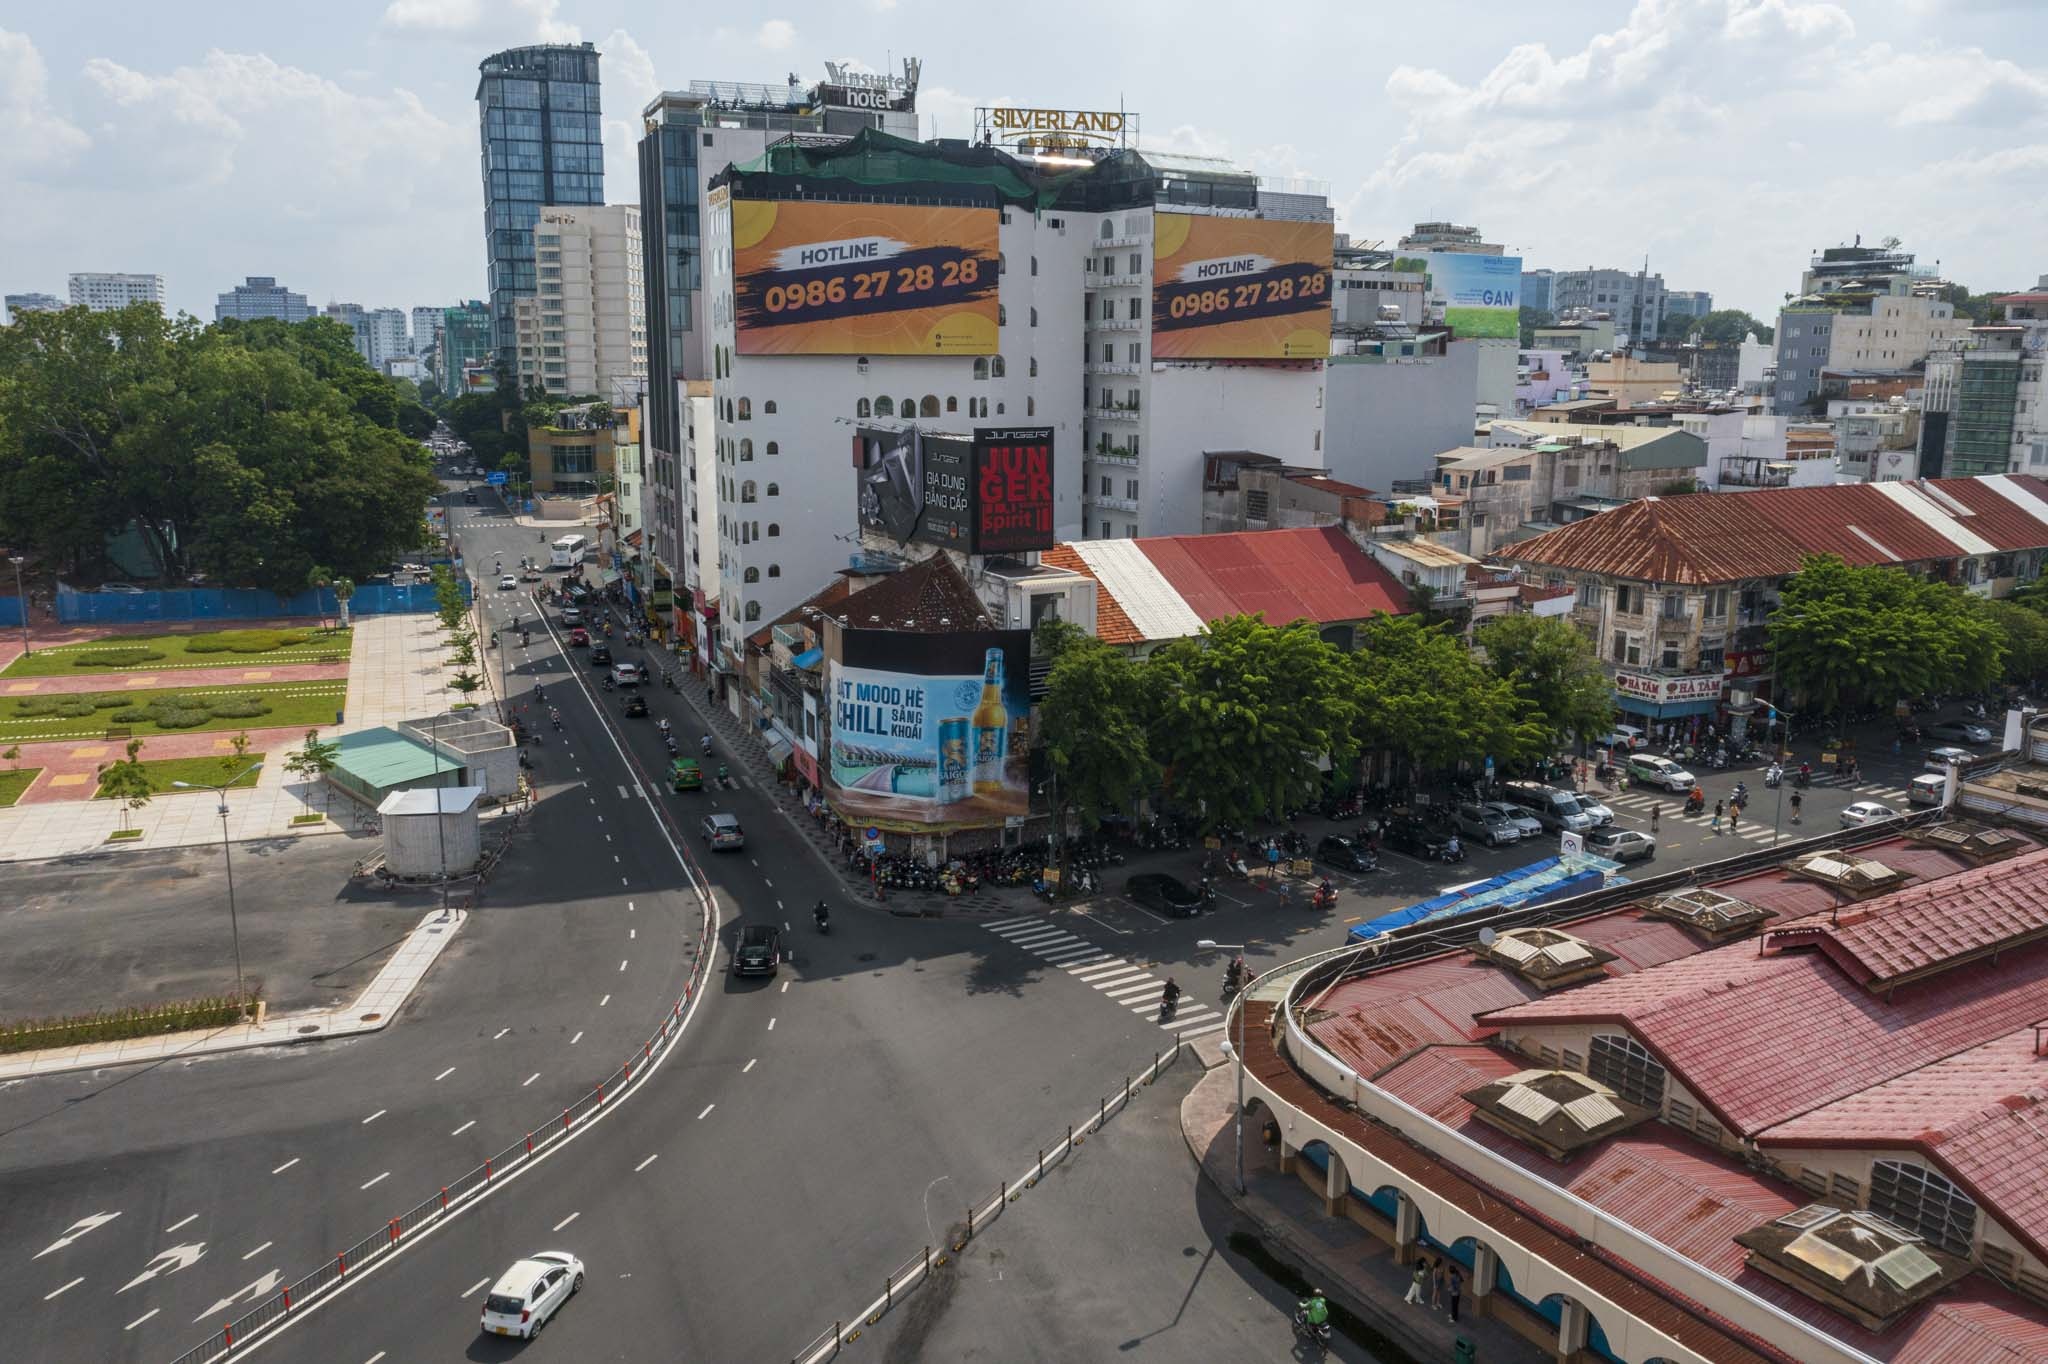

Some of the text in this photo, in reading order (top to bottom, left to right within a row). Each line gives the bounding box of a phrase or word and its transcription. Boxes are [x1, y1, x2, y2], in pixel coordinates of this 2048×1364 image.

[847, 88, 891, 109] hotel
[993, 108, 1123, 132] SILVERLAND
[801, 242, 878, 265] HOTLINE
[1198, 259, 1255, 278] HOTLINE
[765, 258, 978, 313] 0986 27 28 28
[1170, 273, 1325, 319] 0986 27 28 28
[1483, 289, 1513, 306] GAN
[985, 430, 1050, 440] JUNGER
[980, 447, 1047, 474] JUN
[926, 471, 940, 486] GIA
[980, 473, 1052, 503] GER
[856, 682, 900, 705] MOOD
[905, 686, 924, 708] HÈ
[837, 699, 888, 736] CHILL
[891, 724, 922, 740] KHOÁI
